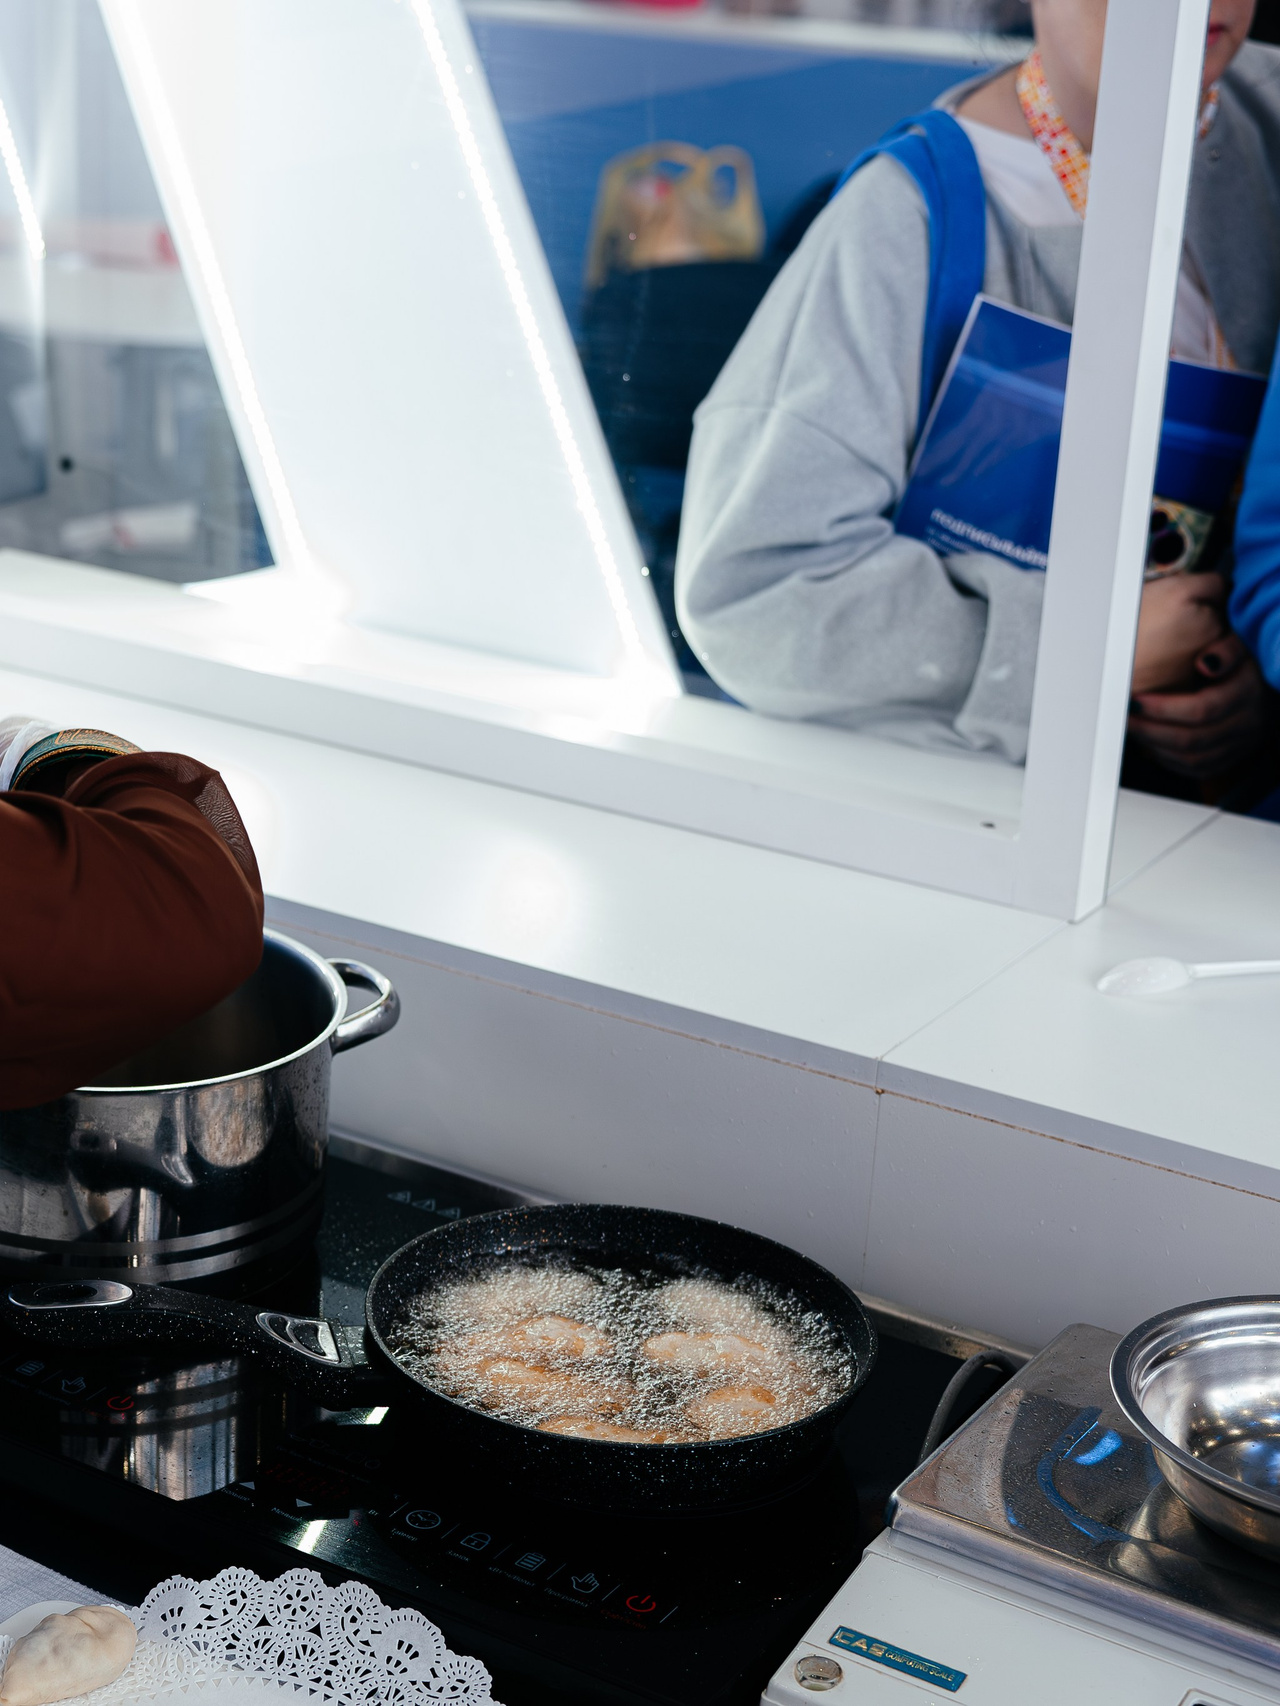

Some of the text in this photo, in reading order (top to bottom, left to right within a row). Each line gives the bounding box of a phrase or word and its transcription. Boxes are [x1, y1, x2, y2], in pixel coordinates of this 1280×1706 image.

[835, 1630, 956, 1682] CAS COMPUTING SCALE
